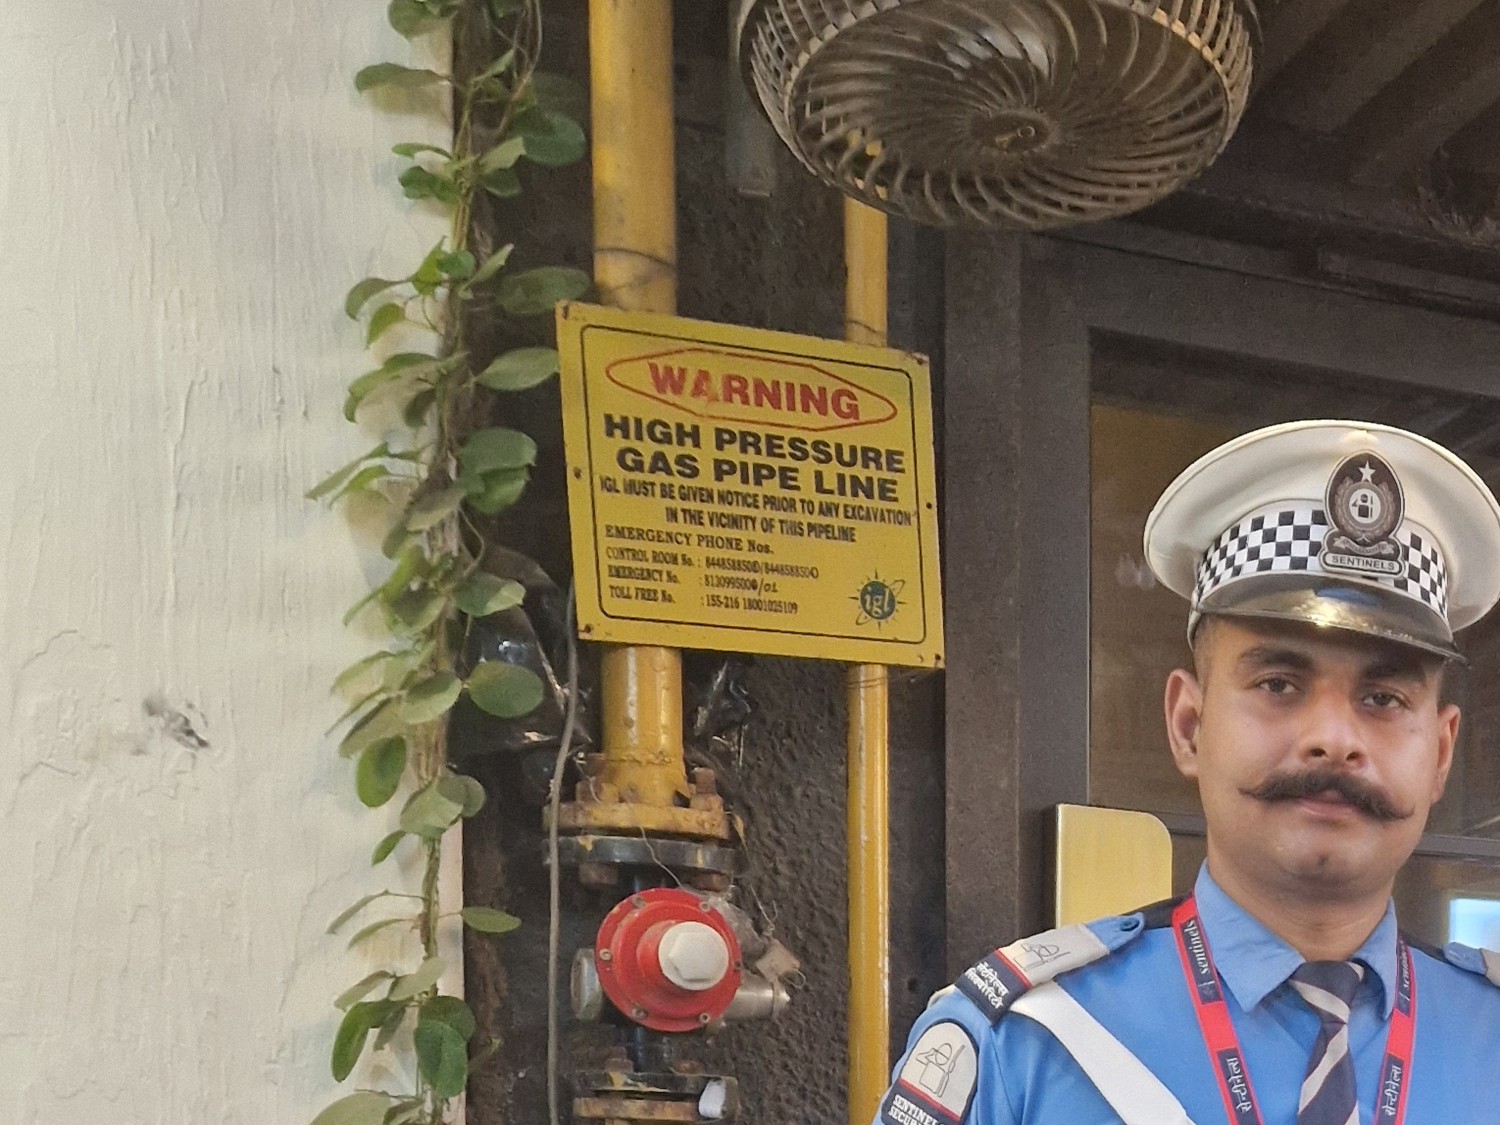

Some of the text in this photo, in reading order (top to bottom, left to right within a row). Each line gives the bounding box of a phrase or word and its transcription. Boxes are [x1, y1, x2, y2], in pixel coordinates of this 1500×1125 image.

[647, 361, 860, 420] WARNING
[603, 413, 906, 474] HIGH PRESSURE
[616, 446, 899, 502] GAS PIPE LINE
[600, 476, 912, 526] IGL MUST BE GIVEN NOTICE PRIOR TO ANY EXCAVATION
[605, 524, 774, 554] EMERGENCY PHONE Nos.
[665, 507, 857, 543] IN THE VICINITY OF THIS PIPELINE
[606, 546, 649, 562] CONTROL
[651, 550, 679, 565] ROOM
[1332, 556, 1395, 570] SENTINELS
[608, 584, 632, 600] TOLL
[634, 587, 659, 602] FREE
[1183, 919, 1210, 976] sentinels
